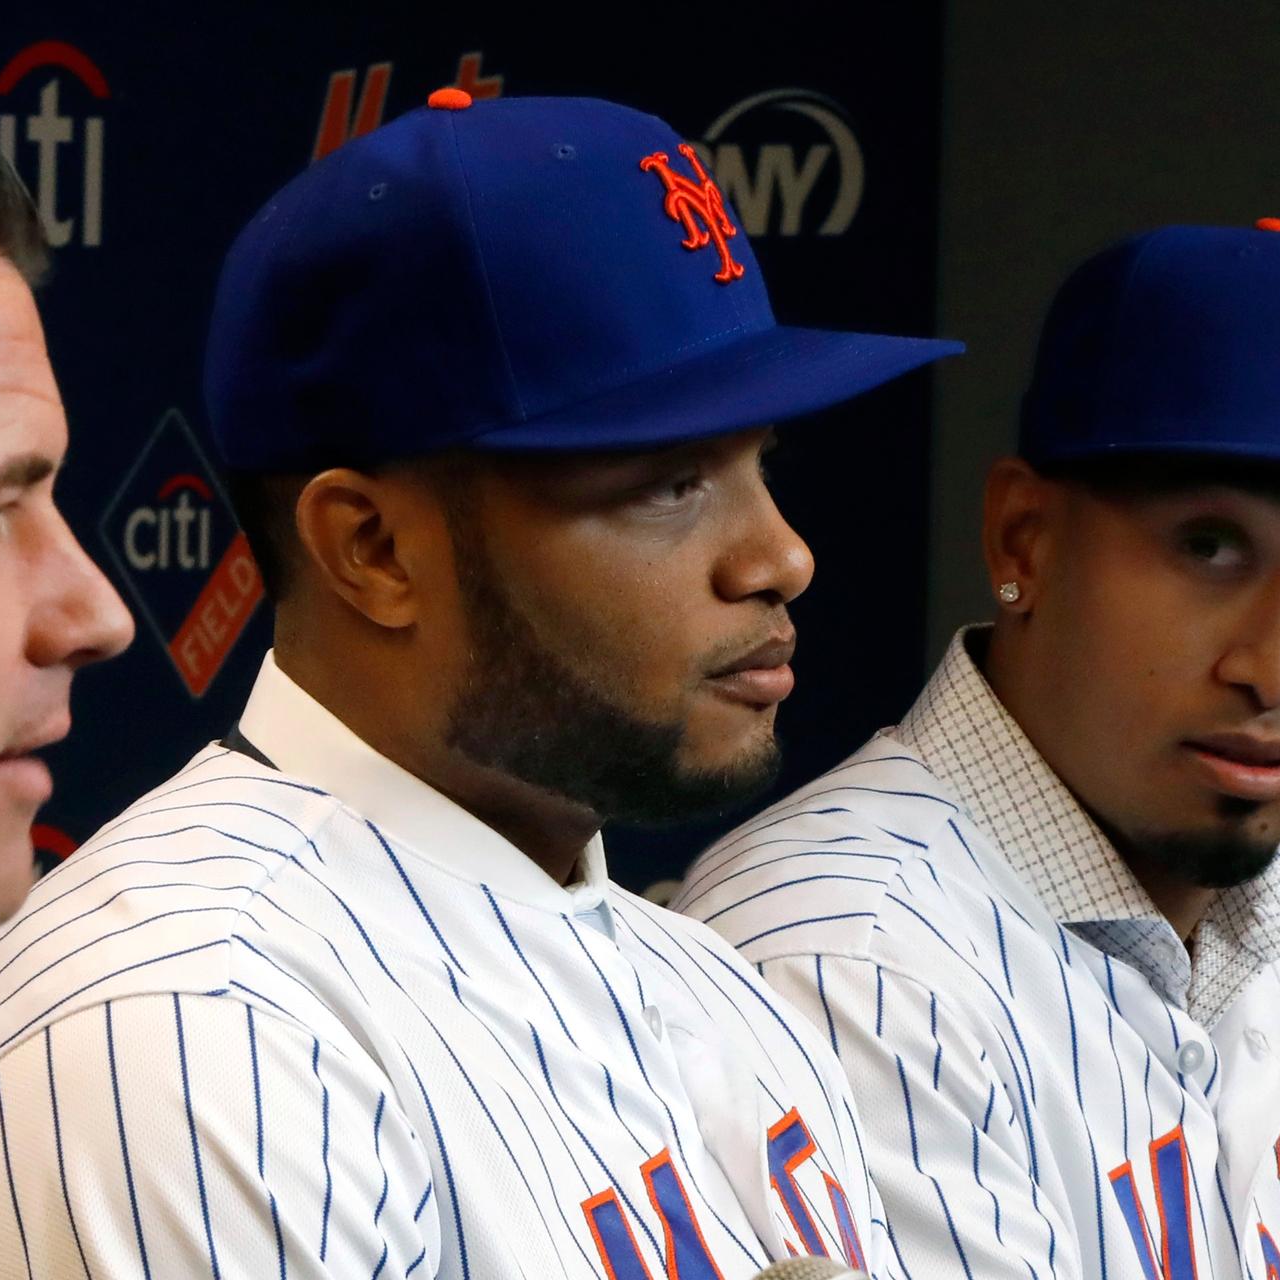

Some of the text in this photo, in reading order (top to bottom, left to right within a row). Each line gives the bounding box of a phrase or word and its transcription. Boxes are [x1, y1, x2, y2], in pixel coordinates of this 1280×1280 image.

[640, 143, 744, 283] NY
[690, 141, 832, 236] NY
[124, 491, 211, 570] citi
[181, 556, 256, 675] FIELD
